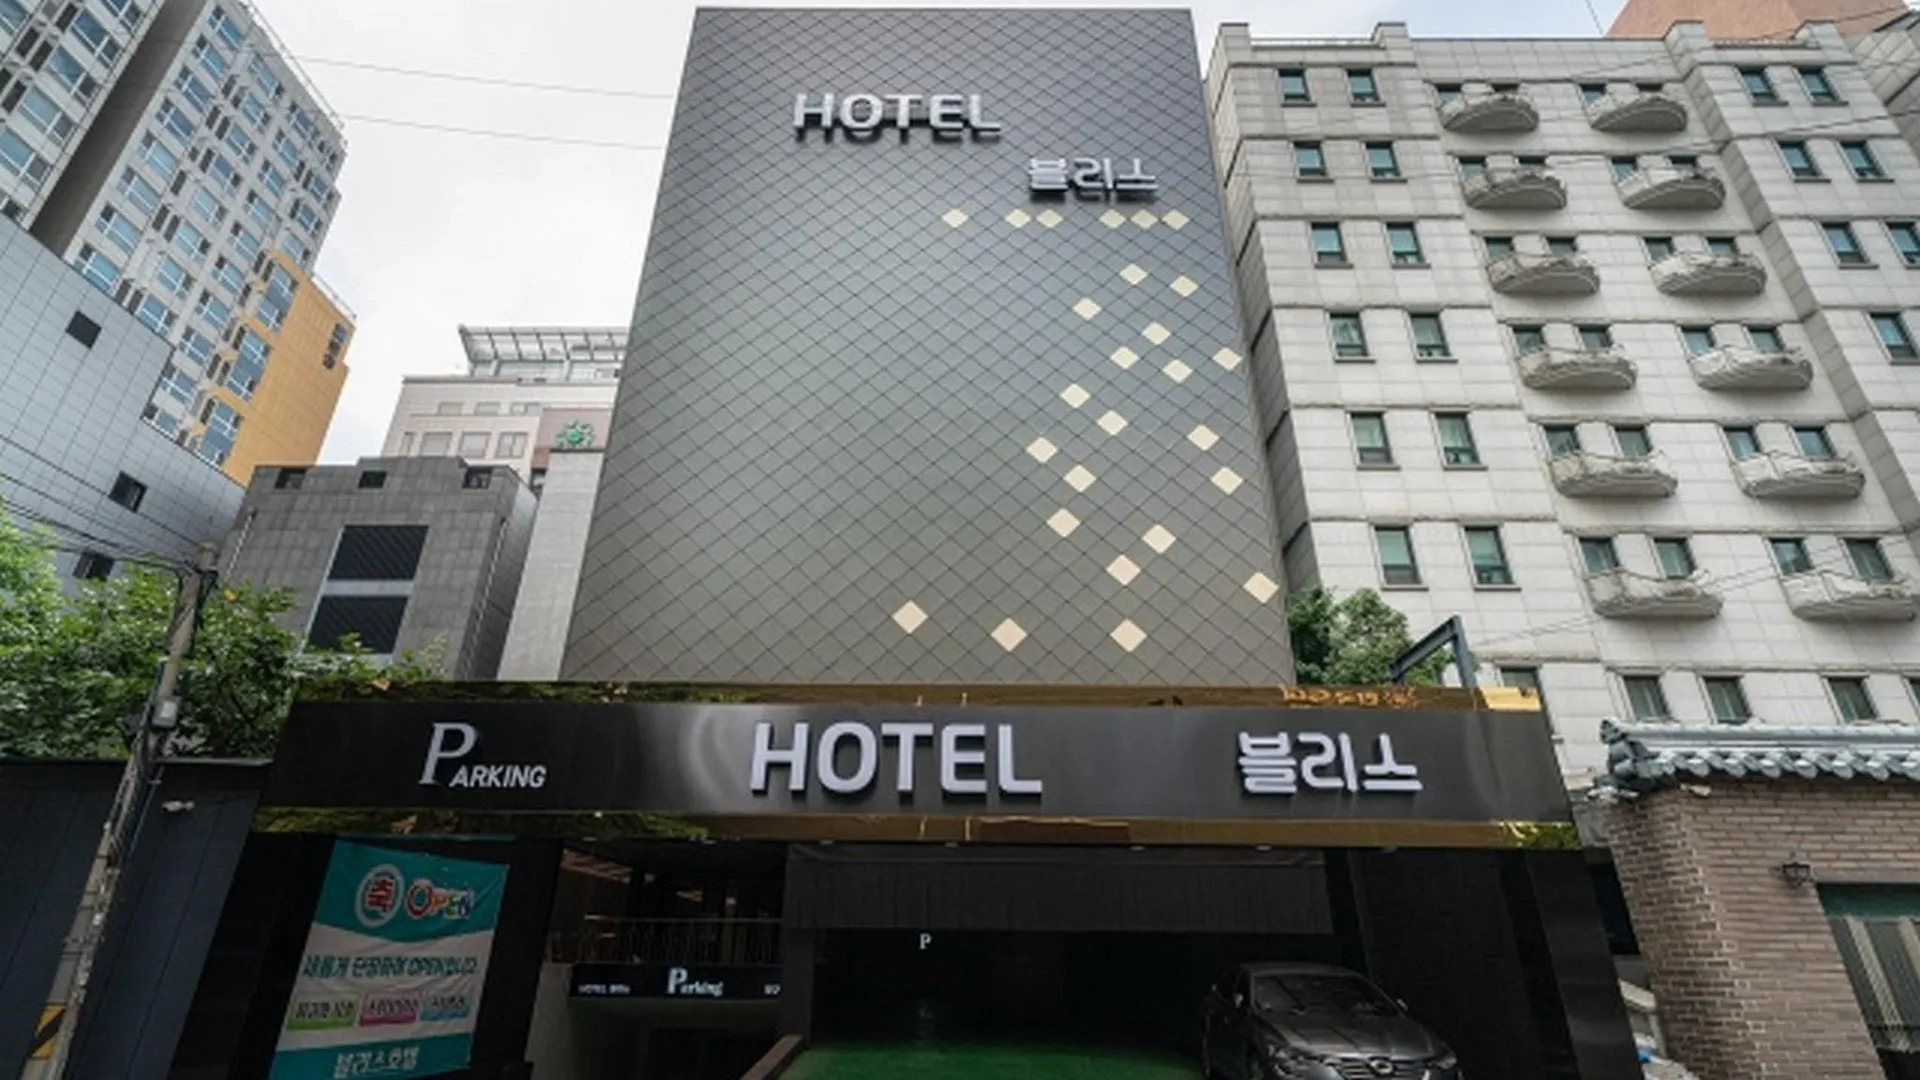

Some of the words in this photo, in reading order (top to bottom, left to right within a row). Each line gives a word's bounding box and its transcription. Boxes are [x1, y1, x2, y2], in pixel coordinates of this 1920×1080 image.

[793, 92, 1001, 131] HOTEL
[1029, 158, 1158, 191] 블리스
[418, 722, 547, 788] PARKING
[751, 722, 1042, 794] HOTEL
[1238, 732, 1424, 793] 블리스
[406, 879, 474, 919] OPEN
[919, 933, 932, 949] P
[667, 967, 724, 997] Parking
